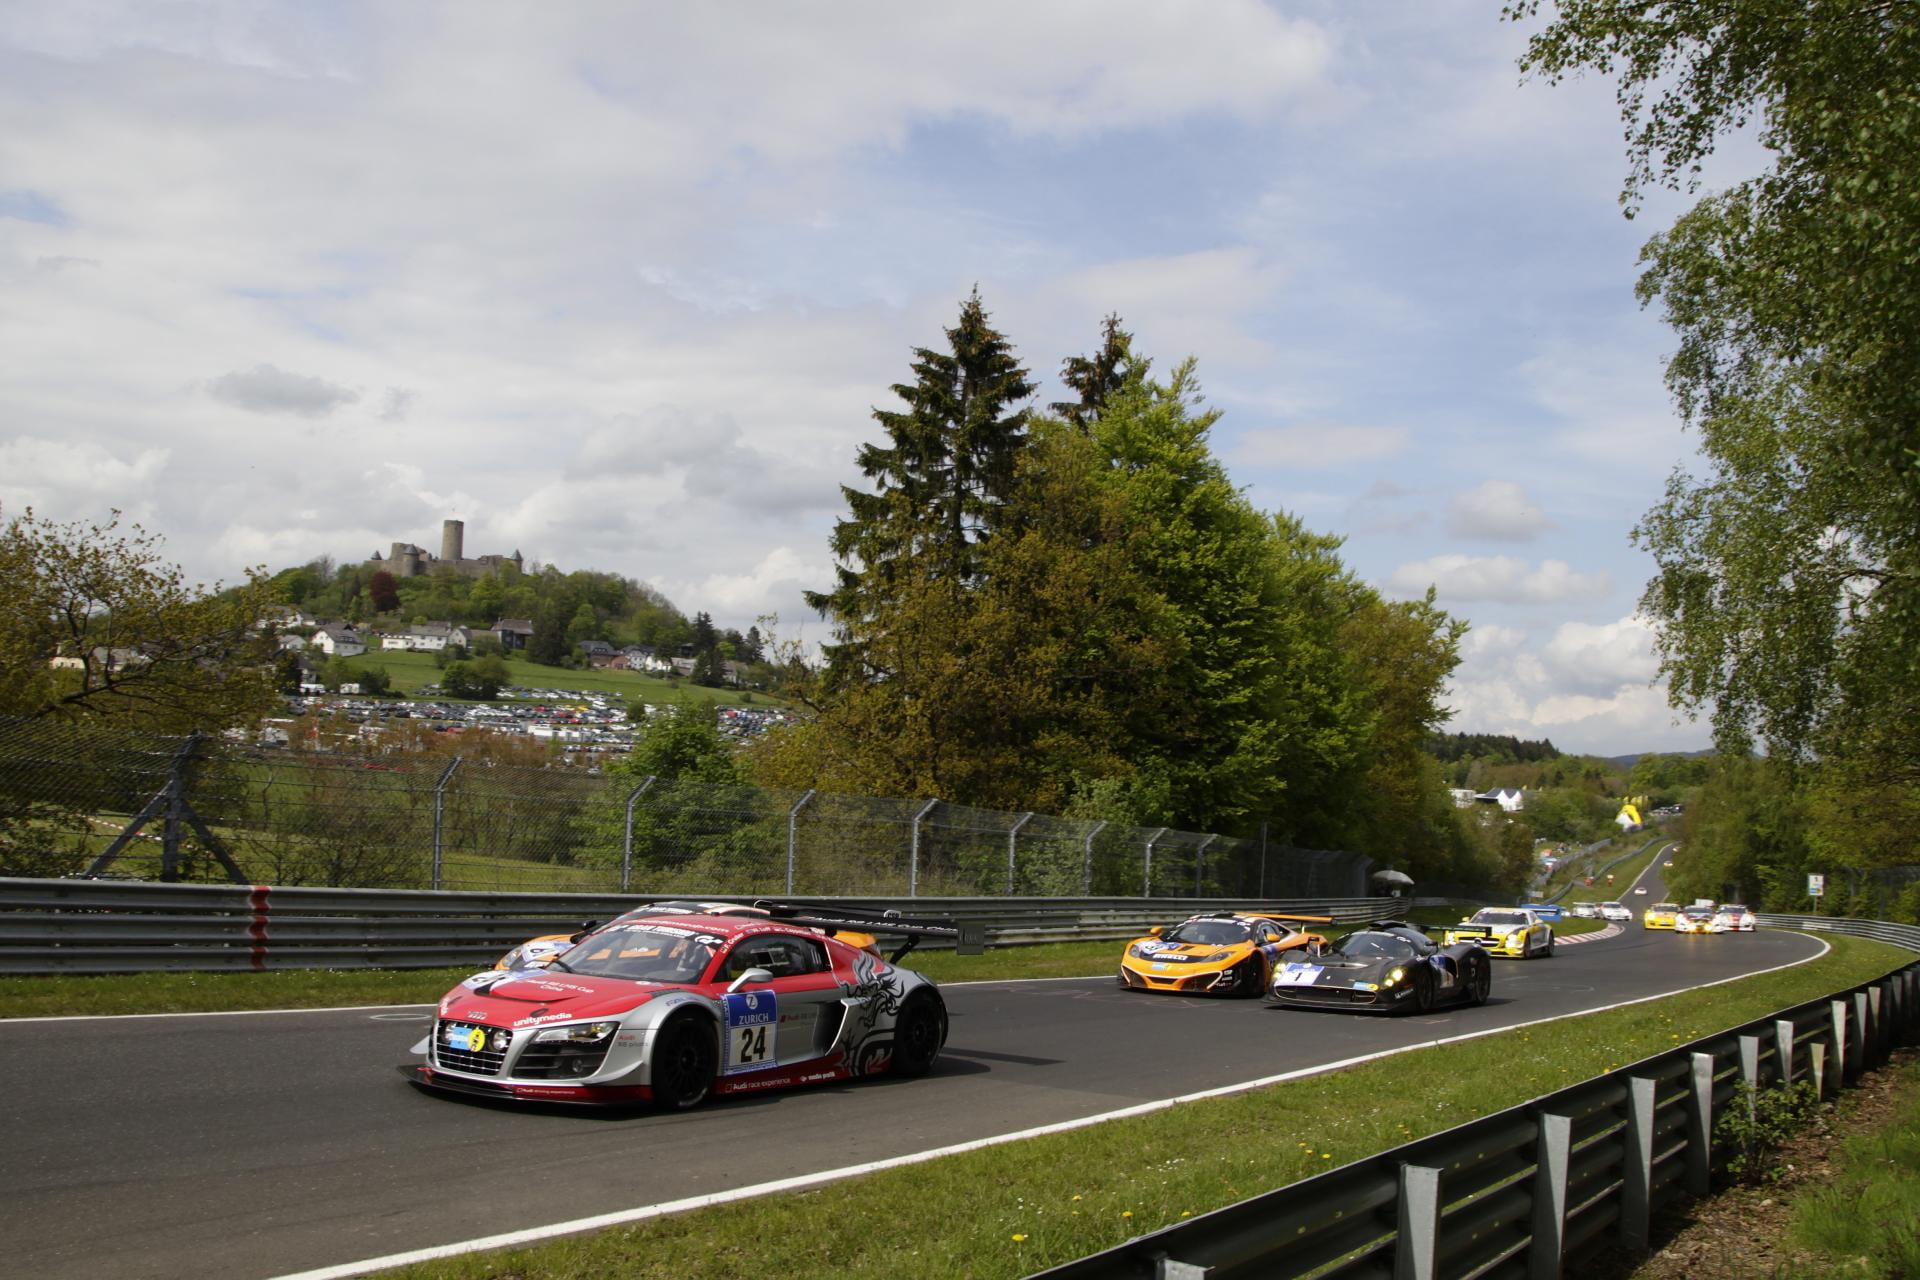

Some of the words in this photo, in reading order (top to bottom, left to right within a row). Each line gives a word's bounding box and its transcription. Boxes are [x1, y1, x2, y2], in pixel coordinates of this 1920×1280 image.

[513, 1012, 572, 1026] unitymedia
[738, 1013, 769, 1025] ZURICH
[741, 1026, 766, 1063] 24
